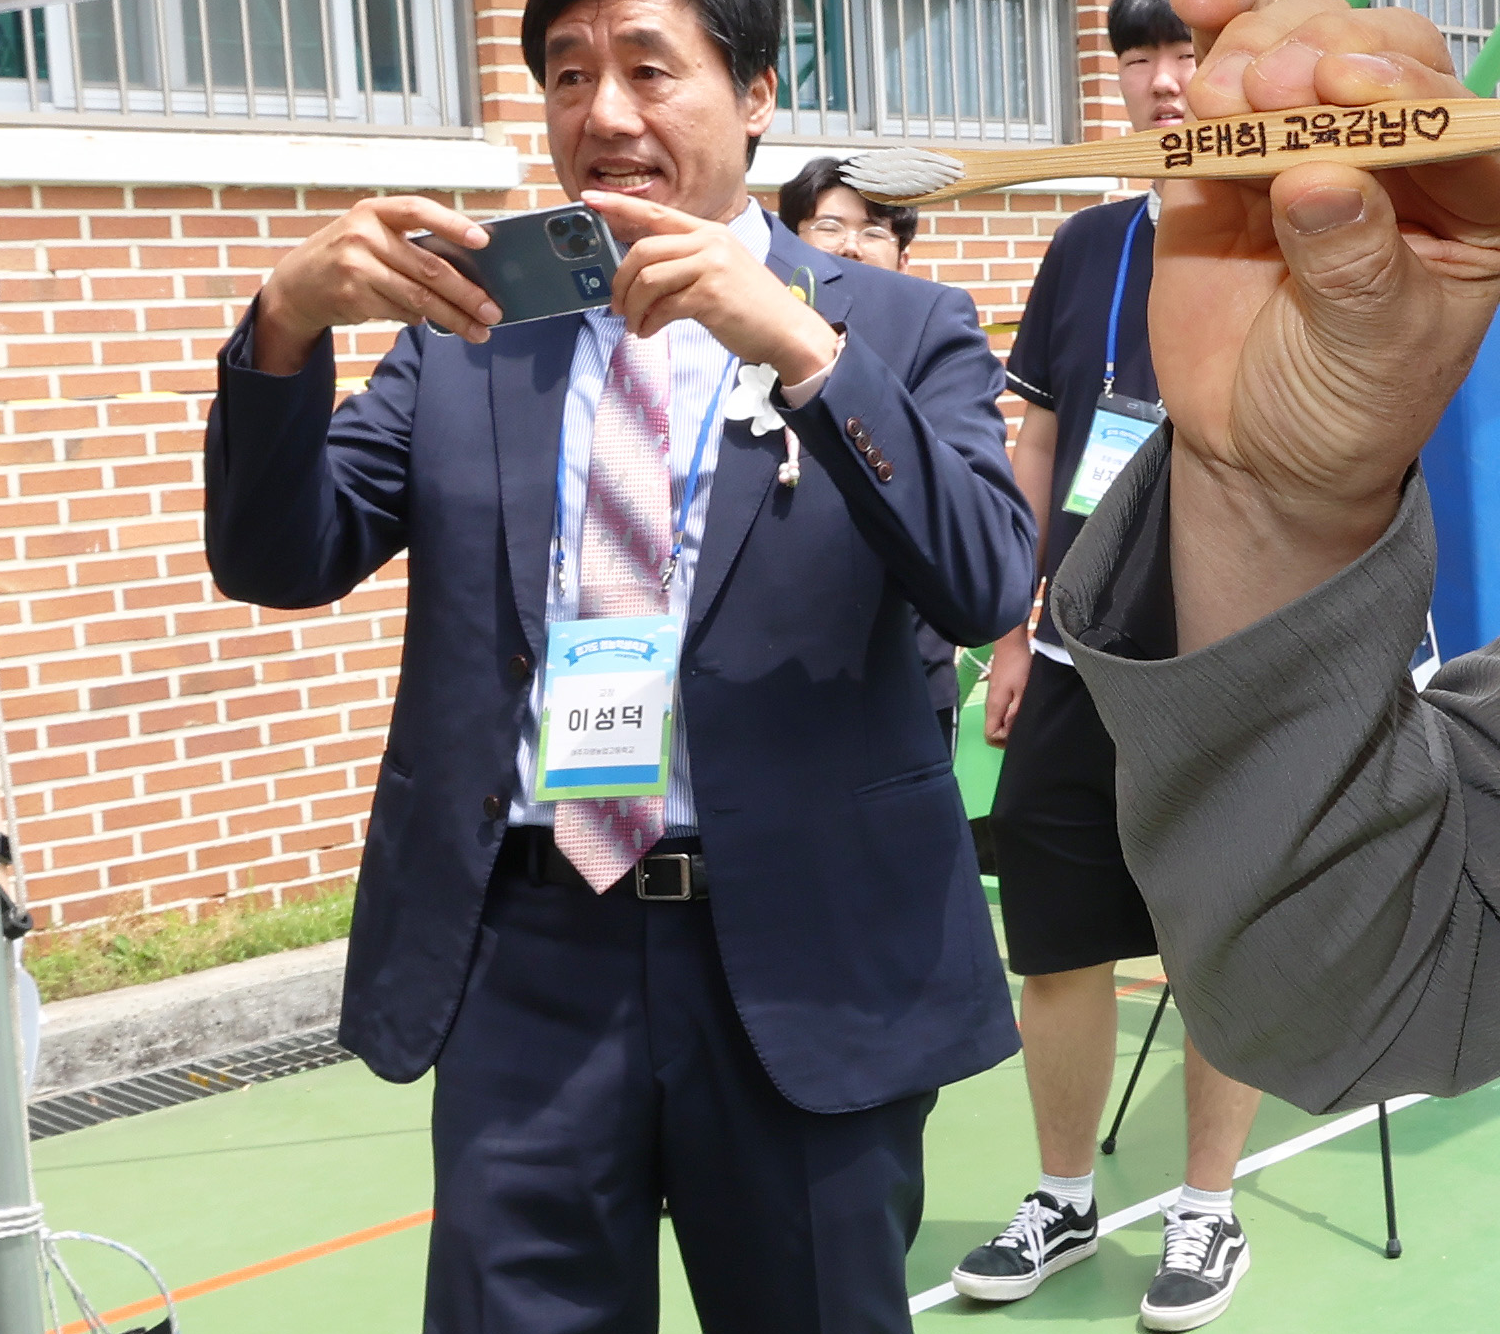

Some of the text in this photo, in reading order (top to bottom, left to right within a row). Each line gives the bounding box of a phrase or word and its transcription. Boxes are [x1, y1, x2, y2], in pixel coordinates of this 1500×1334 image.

[1159, 108, 1408, 170] 임태희 교육감님
[568, 705, 643, 731] 이성덕
